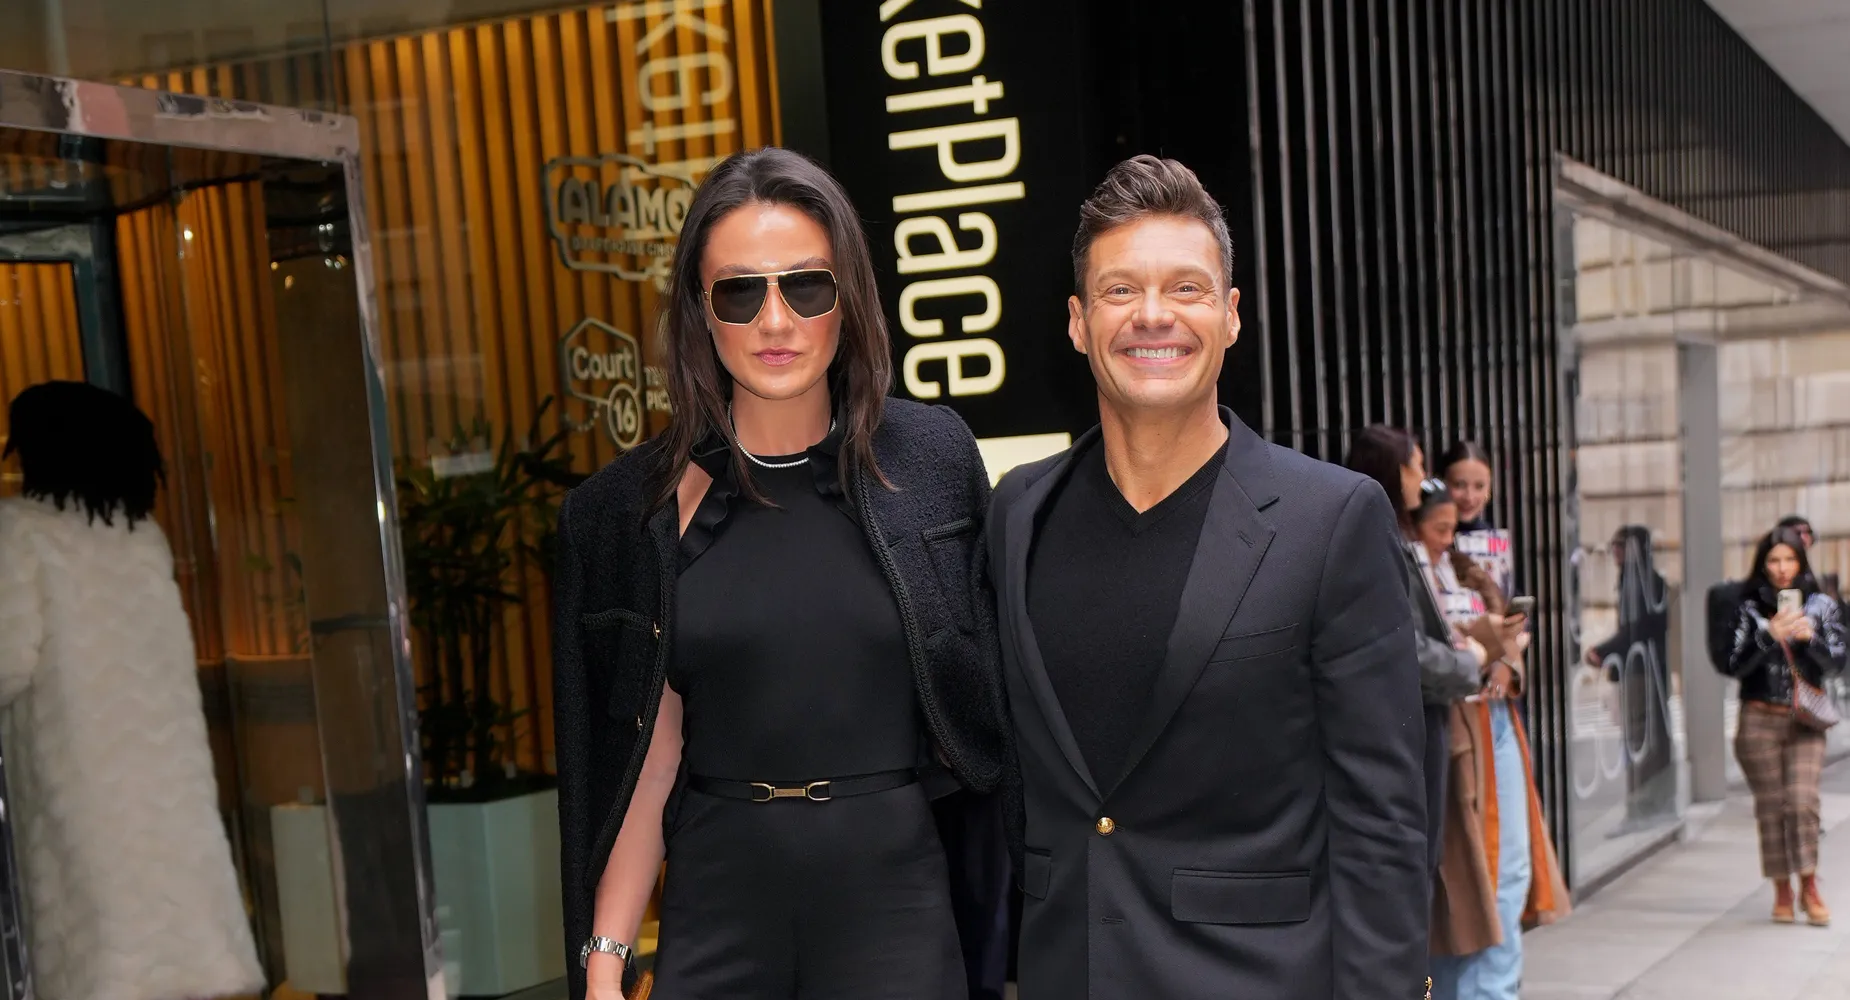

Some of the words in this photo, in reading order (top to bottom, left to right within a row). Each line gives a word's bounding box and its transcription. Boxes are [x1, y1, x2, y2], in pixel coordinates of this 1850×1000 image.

[557, 177, 694, 236] ALAMO
[572, 345, 635, 380] Court
[612, 397, 637, 433] 16
